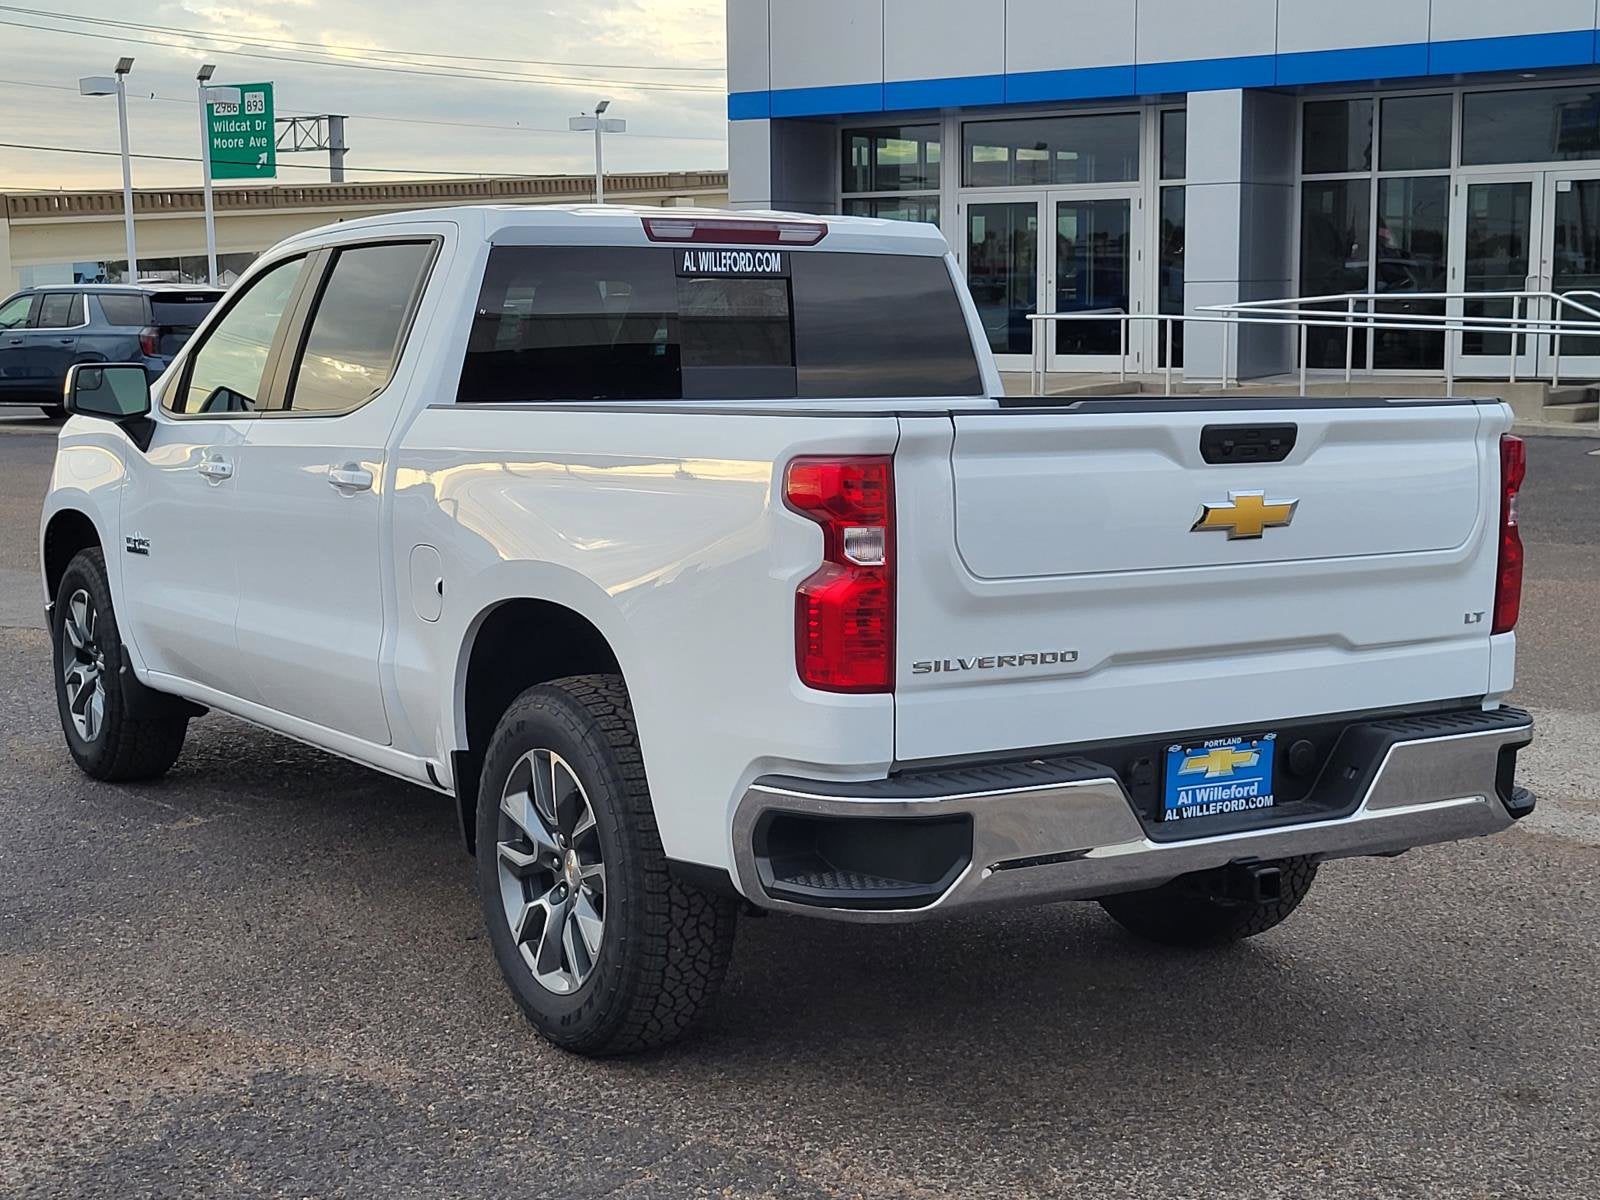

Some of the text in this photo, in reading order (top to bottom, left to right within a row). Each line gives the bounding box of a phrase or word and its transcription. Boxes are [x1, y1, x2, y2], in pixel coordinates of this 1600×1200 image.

[246, 100, 264, 112] 893
[213, 120, 266, 132] Wildcat Dr
[214, 136, 267, 149] Moore Ave
[683, 251, 781, 272] AL WILLEFORD.COM
[1464, 611, 1486, 624] LT
[912, 650, 1079, 674] SILVERADO
[1204, 737, 1242, 748] PORTLAND
[1177, 782, 1258, 806] Al Willeford
[1164, 795, 1274, 822] AL WILLEFORD.COM
